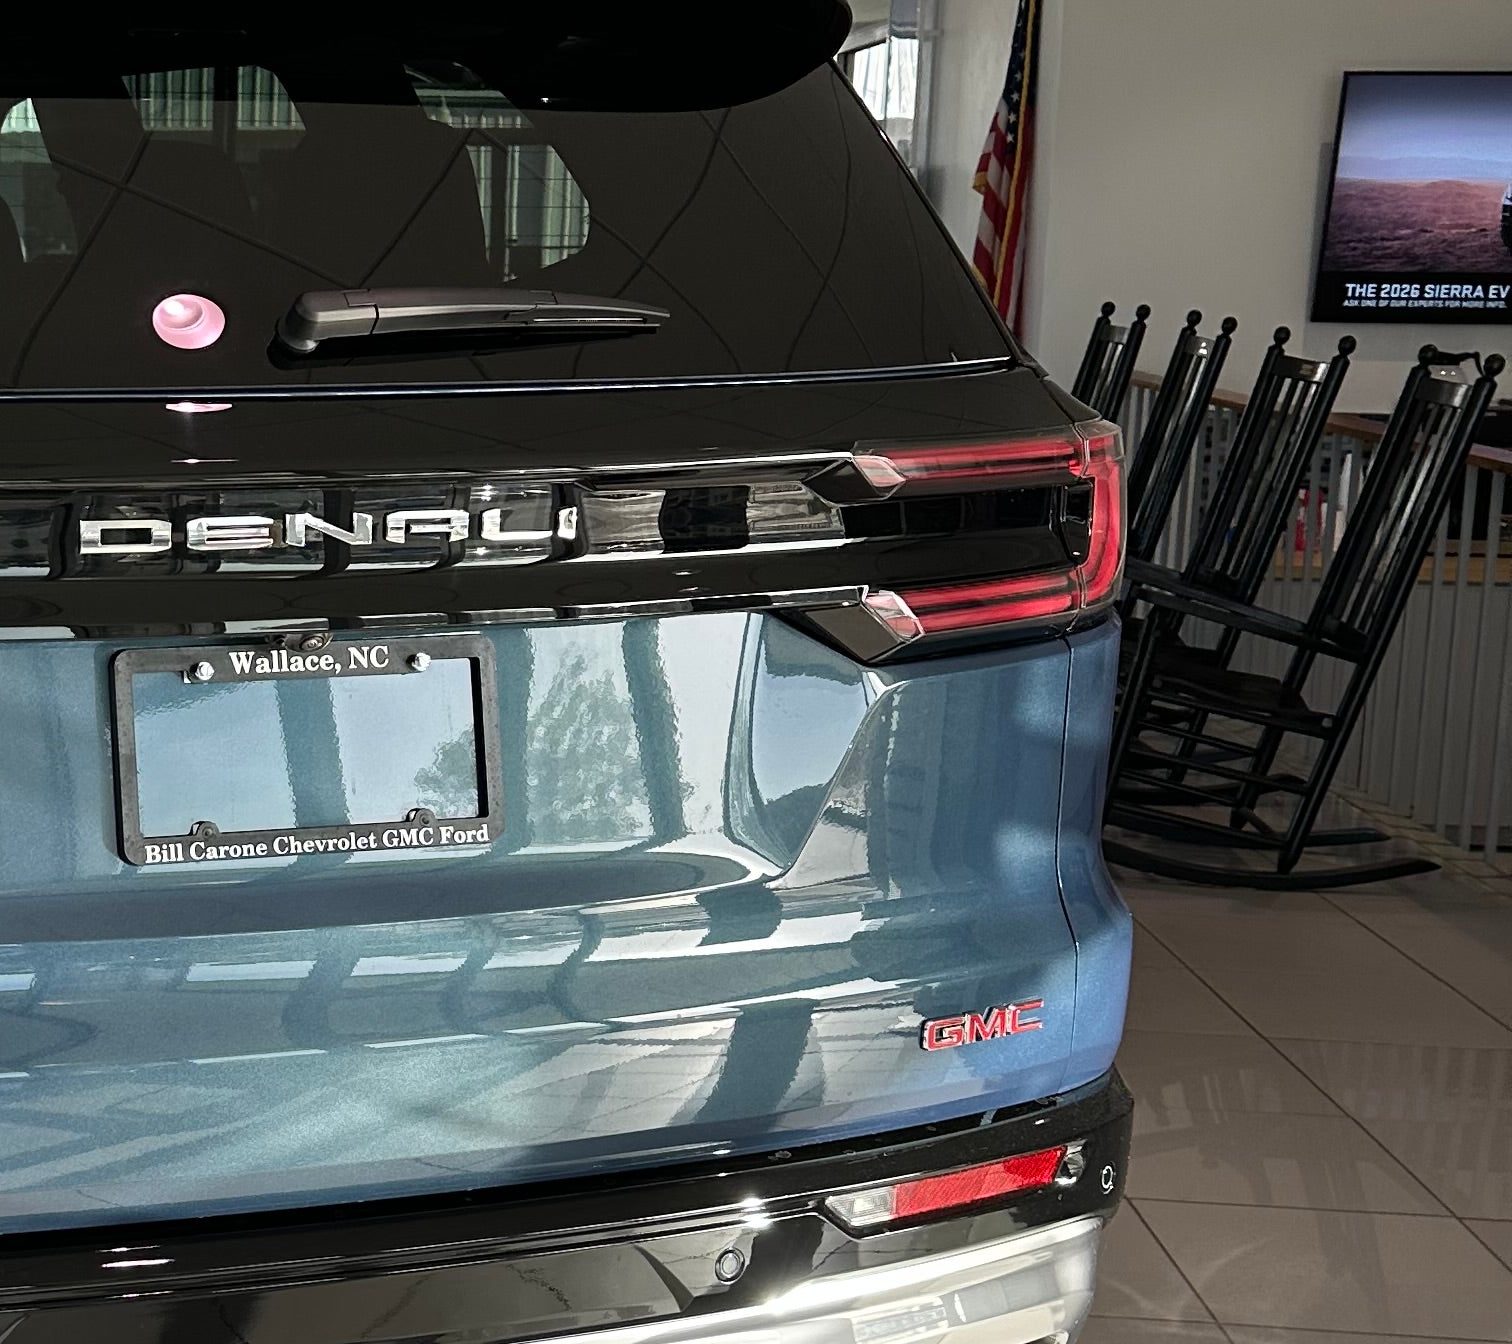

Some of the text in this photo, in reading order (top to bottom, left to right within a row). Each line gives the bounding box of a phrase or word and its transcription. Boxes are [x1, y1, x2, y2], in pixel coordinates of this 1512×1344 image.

[1343, 299, 1360, 307] ASK
[1361, 299, 1376, 307] ONE
[1378, 299, 1389, 307] OF
[1390, 299, 1406, 308] OUR
[1408, 300, 1443, 308] EXPERTS
[1445, 300, 1460, 308] FOR
[1461, 300, 1484, 309] MORE
[1345, 283, 1510, 299] THE 2026 SIERRA EV
[79, 507, 578, 554] DENALI
[229, 645, 390, 675] Wallace, NC
[144, 824, 490, 865] Bill Carone Chevrolet GMC Ford
[920, 996, 1045, 1052] GMC
